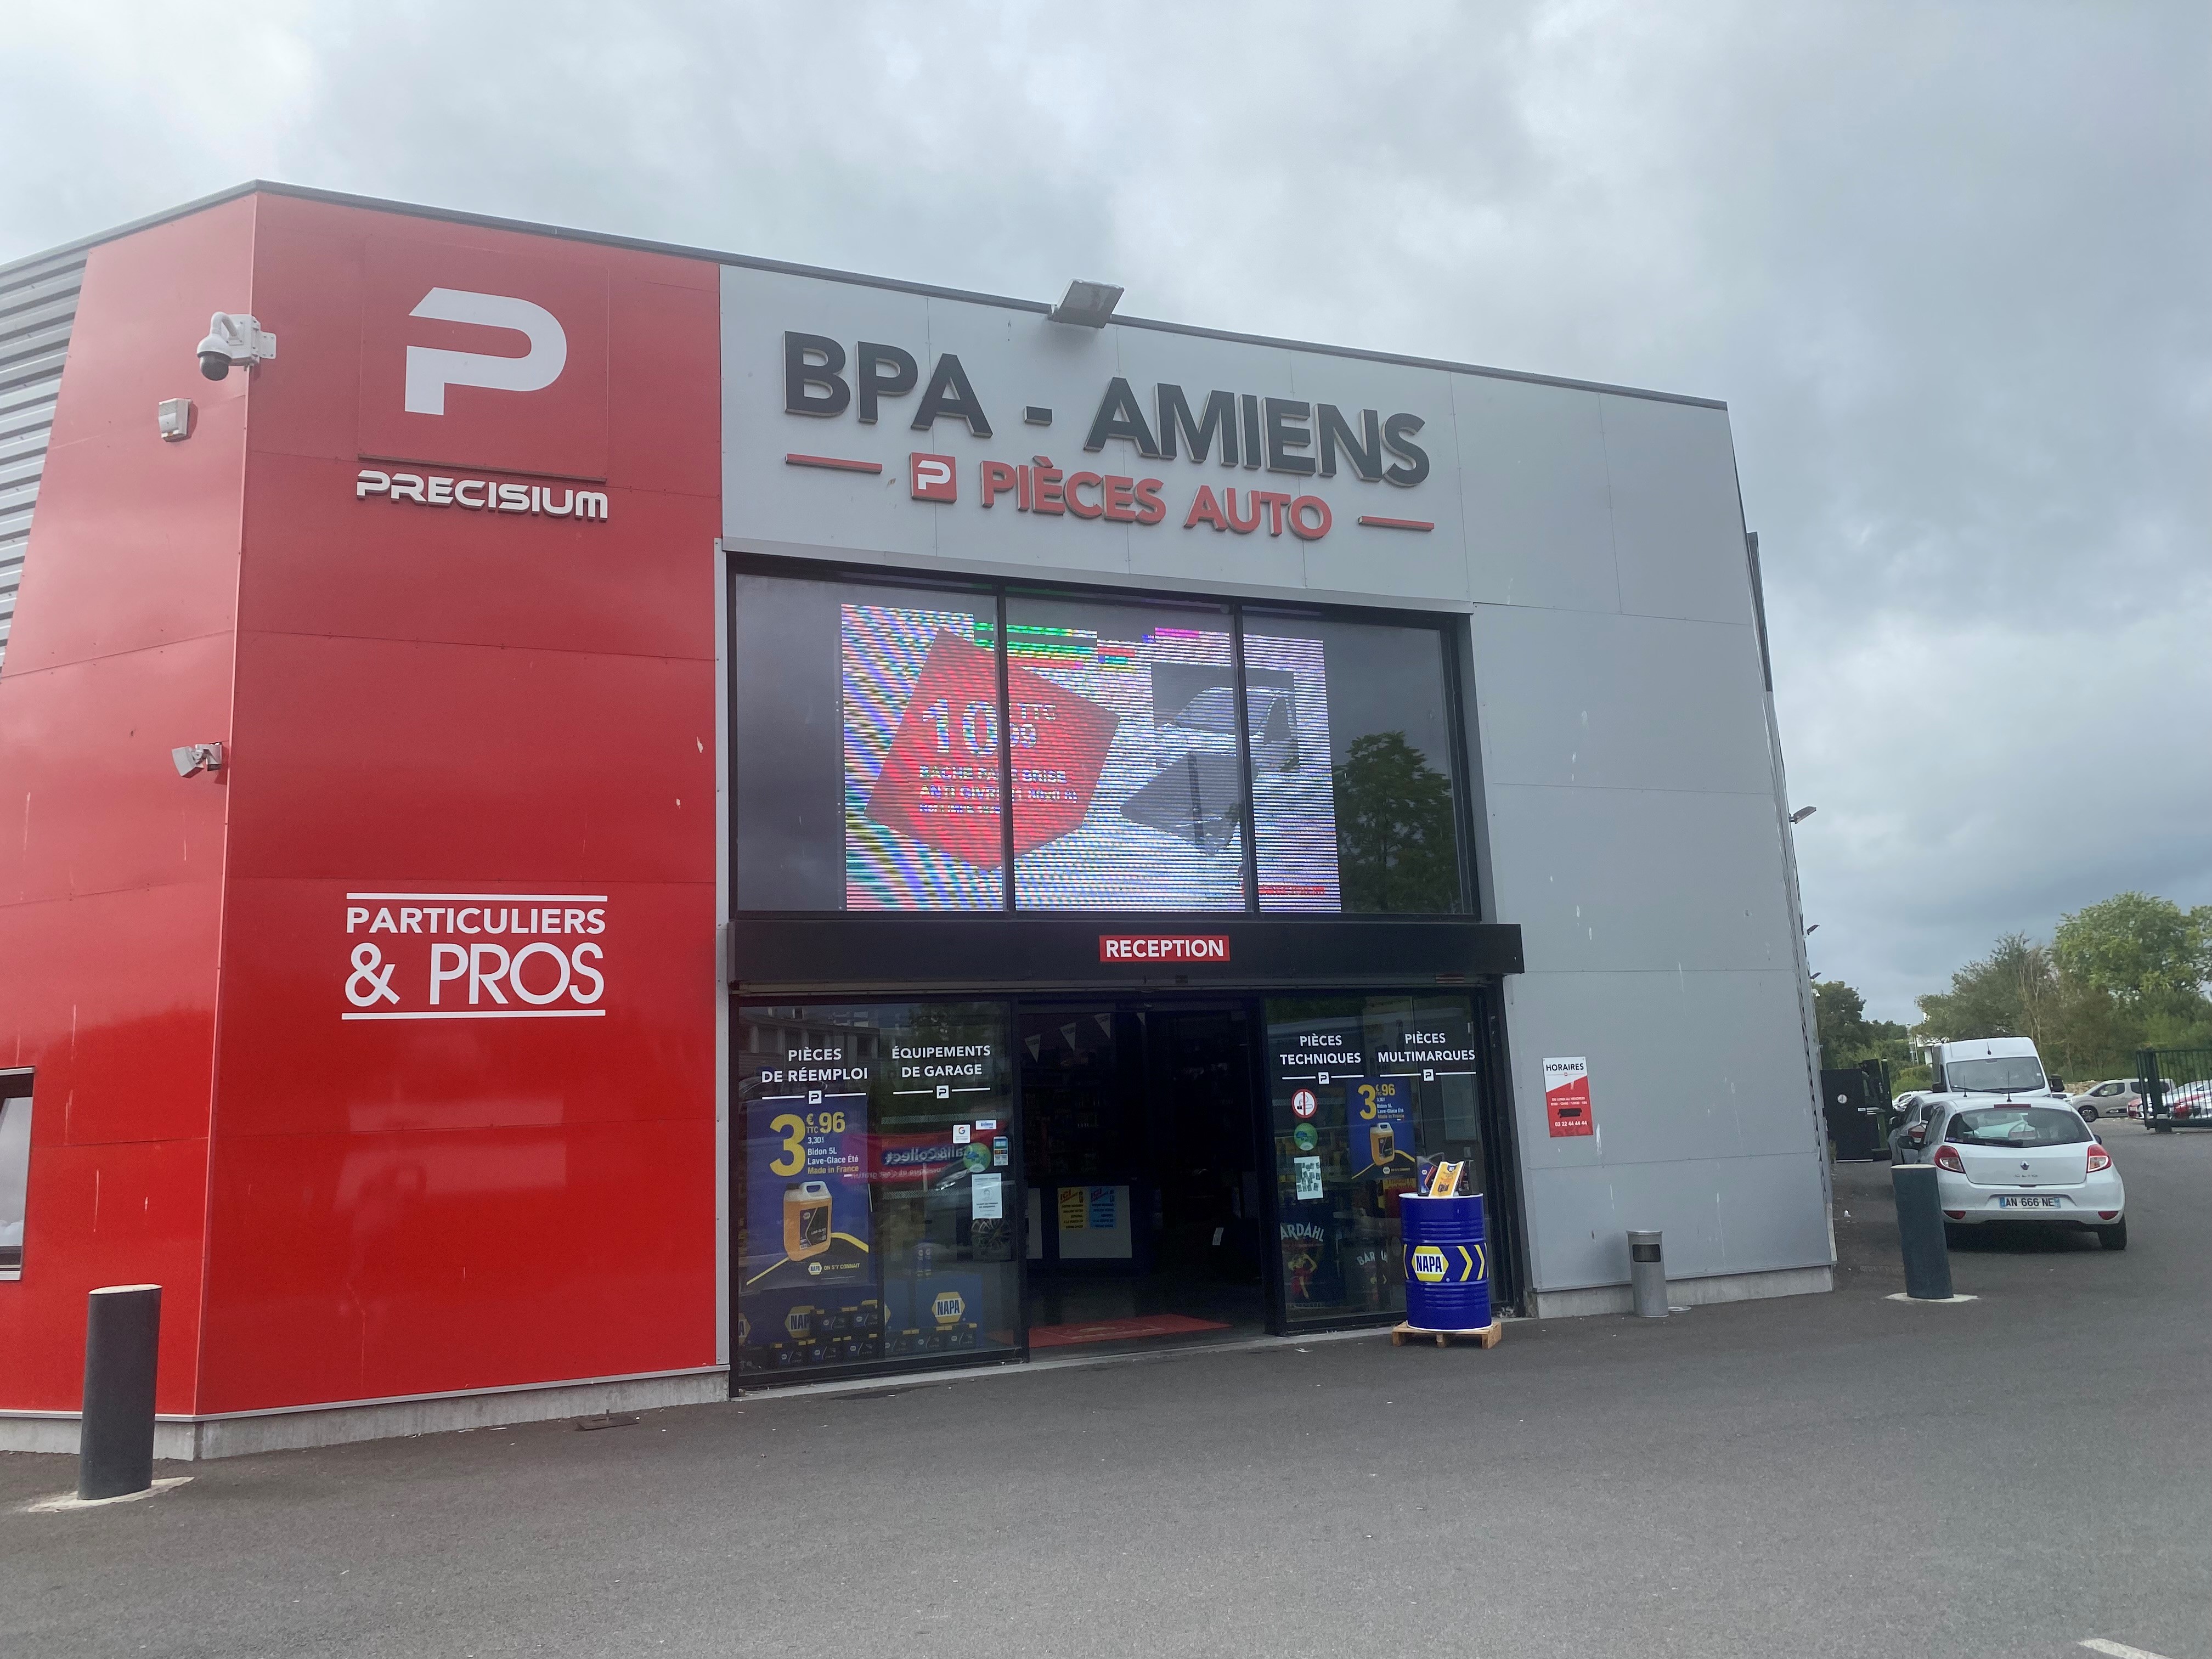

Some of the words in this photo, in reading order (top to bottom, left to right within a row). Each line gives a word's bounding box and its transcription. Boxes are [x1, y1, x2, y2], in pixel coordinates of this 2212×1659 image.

[785, 330, 994, 438] BPA
[1083, 376, 1430, 487] AMIENS
[357, 469, 608, 521] PRECISIUM
[980, 455, 1166, 525] PIÈCES
[1183, 485, 1333, 540] AUTO
[347, 907, 606, 934] PARTICULIERS
[1106, 939, 1224, 958] RECEPTION
[345, 942, 400, 1007] &
[430, 942, 605, 1005] PROS
[1300, 1033, 1342, 1047] PIÈCES
[1404, 1031, 1446, 1044] PIÈCES
[788, 1046, 842, 1062] PIÈCES
[892, 1045, 991, 1059] ÉQUIPEMENTS
[1279, 1052, 1361, 1065] TECHNIQUES
[1378, 1049, 1476, 1063] MULTIMARQUES
[761, 1070, 783, 1083] DE
[788, 1066, 868, 1082] RÉEMPLOI
[902, 1066, 921, 1077] DE
[924, 1064, 983, 1077] GARAGE
[1545, 1063, 1584, 1071] HORAIRES
[1357, 1084, 1377, 1120] 3
[1381, 1084, 1396, 1096] 96
[769, 1114, 806, 1177] 3
[806, 1113, 814, 1126] €
[819, 1111, 846, 1134] 96
[808, 1156, 847, 1165] Lave-Glace
[848, 1154, 859, 1163] Été
[1280, 1221, 1325, 1242] ARDAHL
[1416, 1255, 1442, 1272] NAPA
[936, 1300, 960, 1316] NAPA
[791, 1314, 809, 1330] NAP
